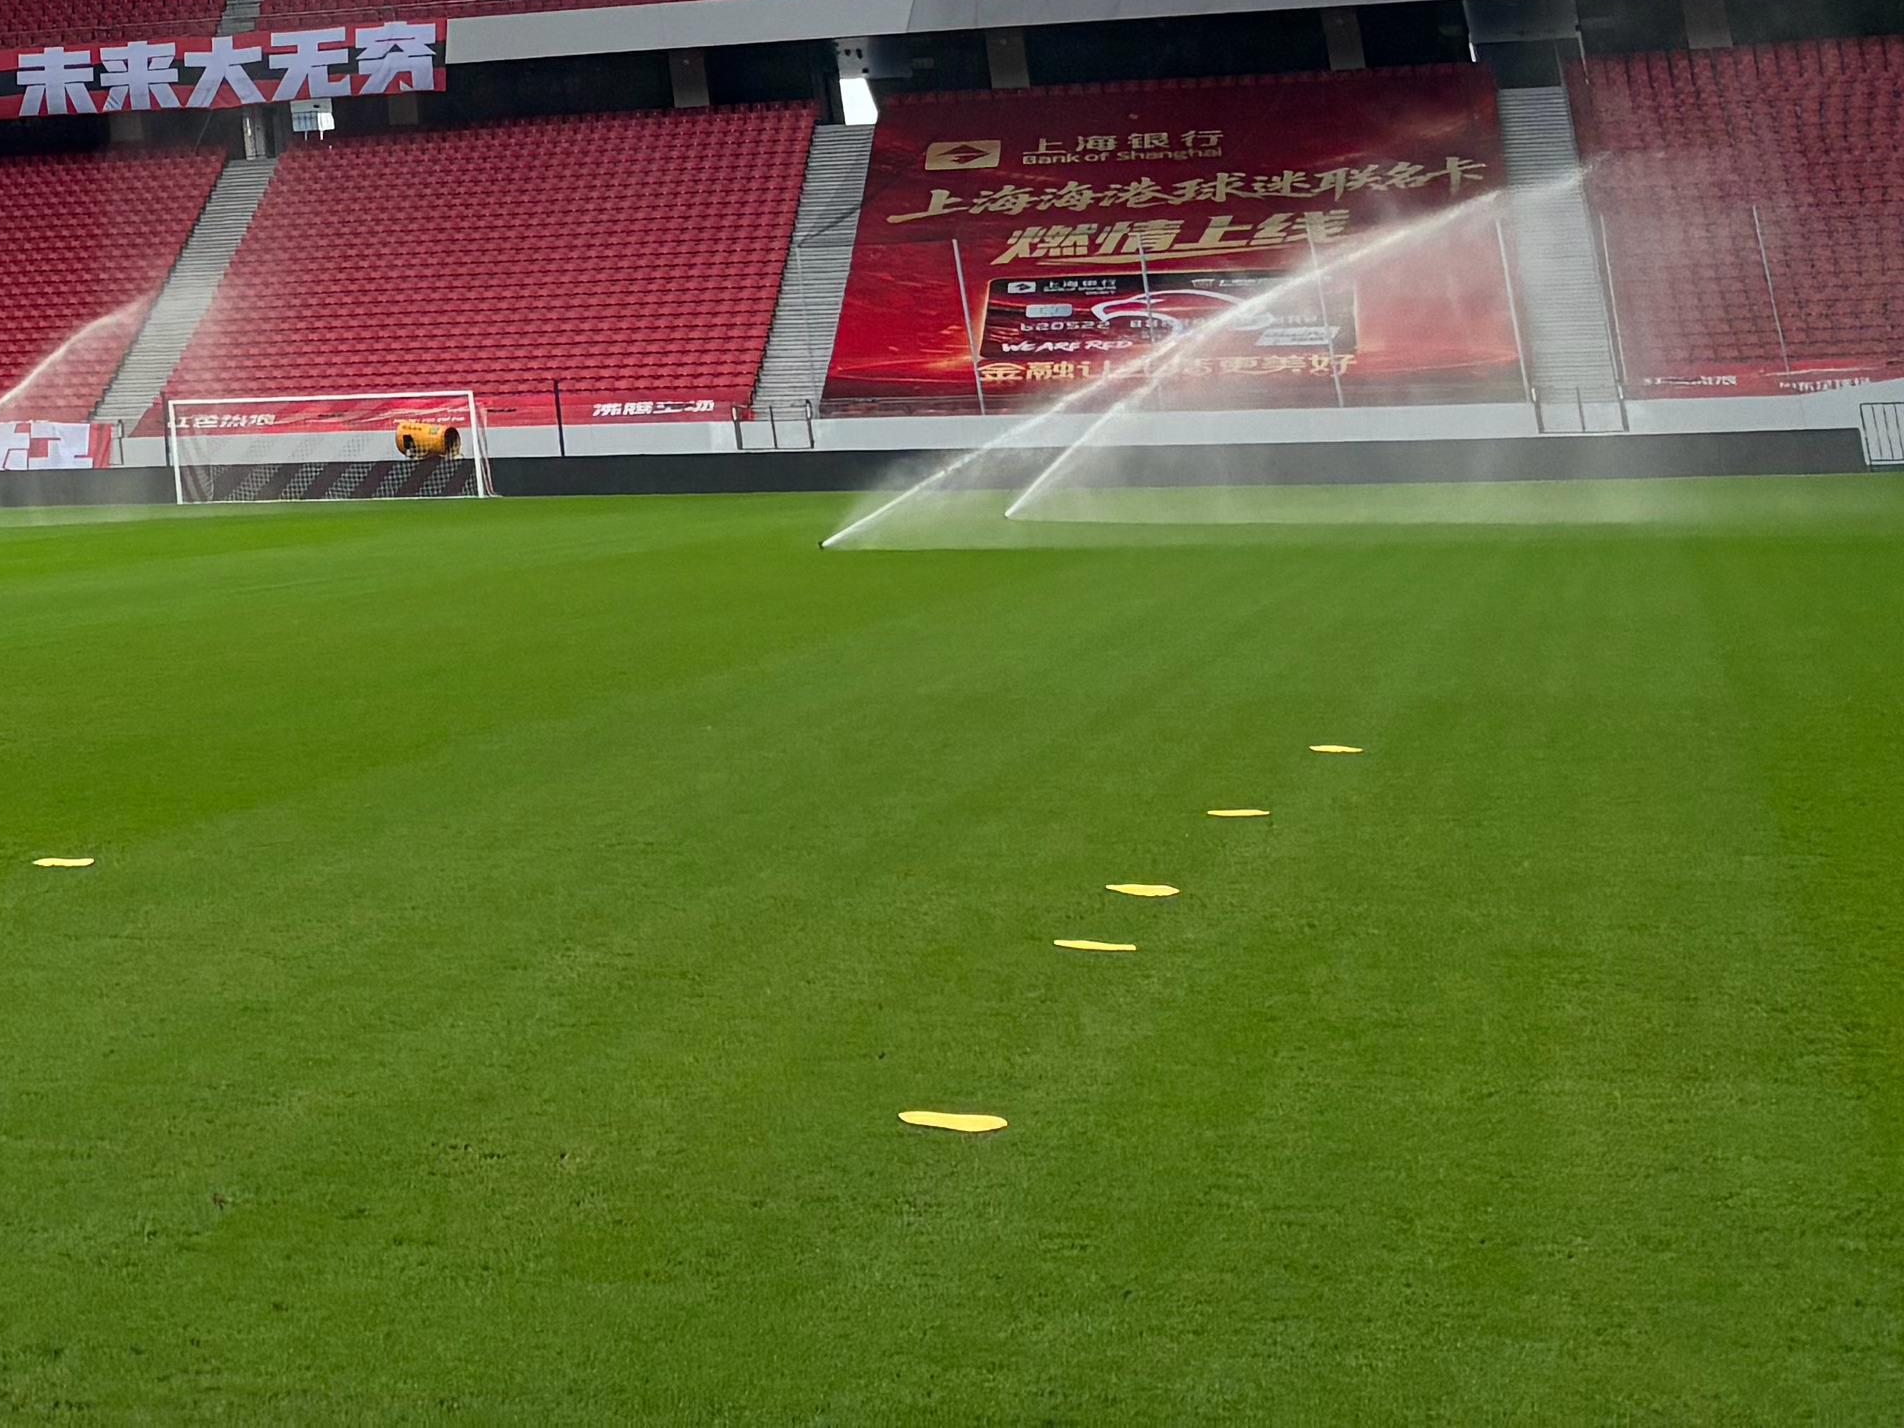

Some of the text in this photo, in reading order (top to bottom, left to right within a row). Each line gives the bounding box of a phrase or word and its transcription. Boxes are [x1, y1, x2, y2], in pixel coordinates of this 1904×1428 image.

[15, 20, 437, 117] 未来大无穷
[1023, 130, 1223, 155] 上海银行
[1023, 147, 1223, 165] Bank of Shanghai
[887, 156, 1487, 223] 上海海港球迷联名卡
